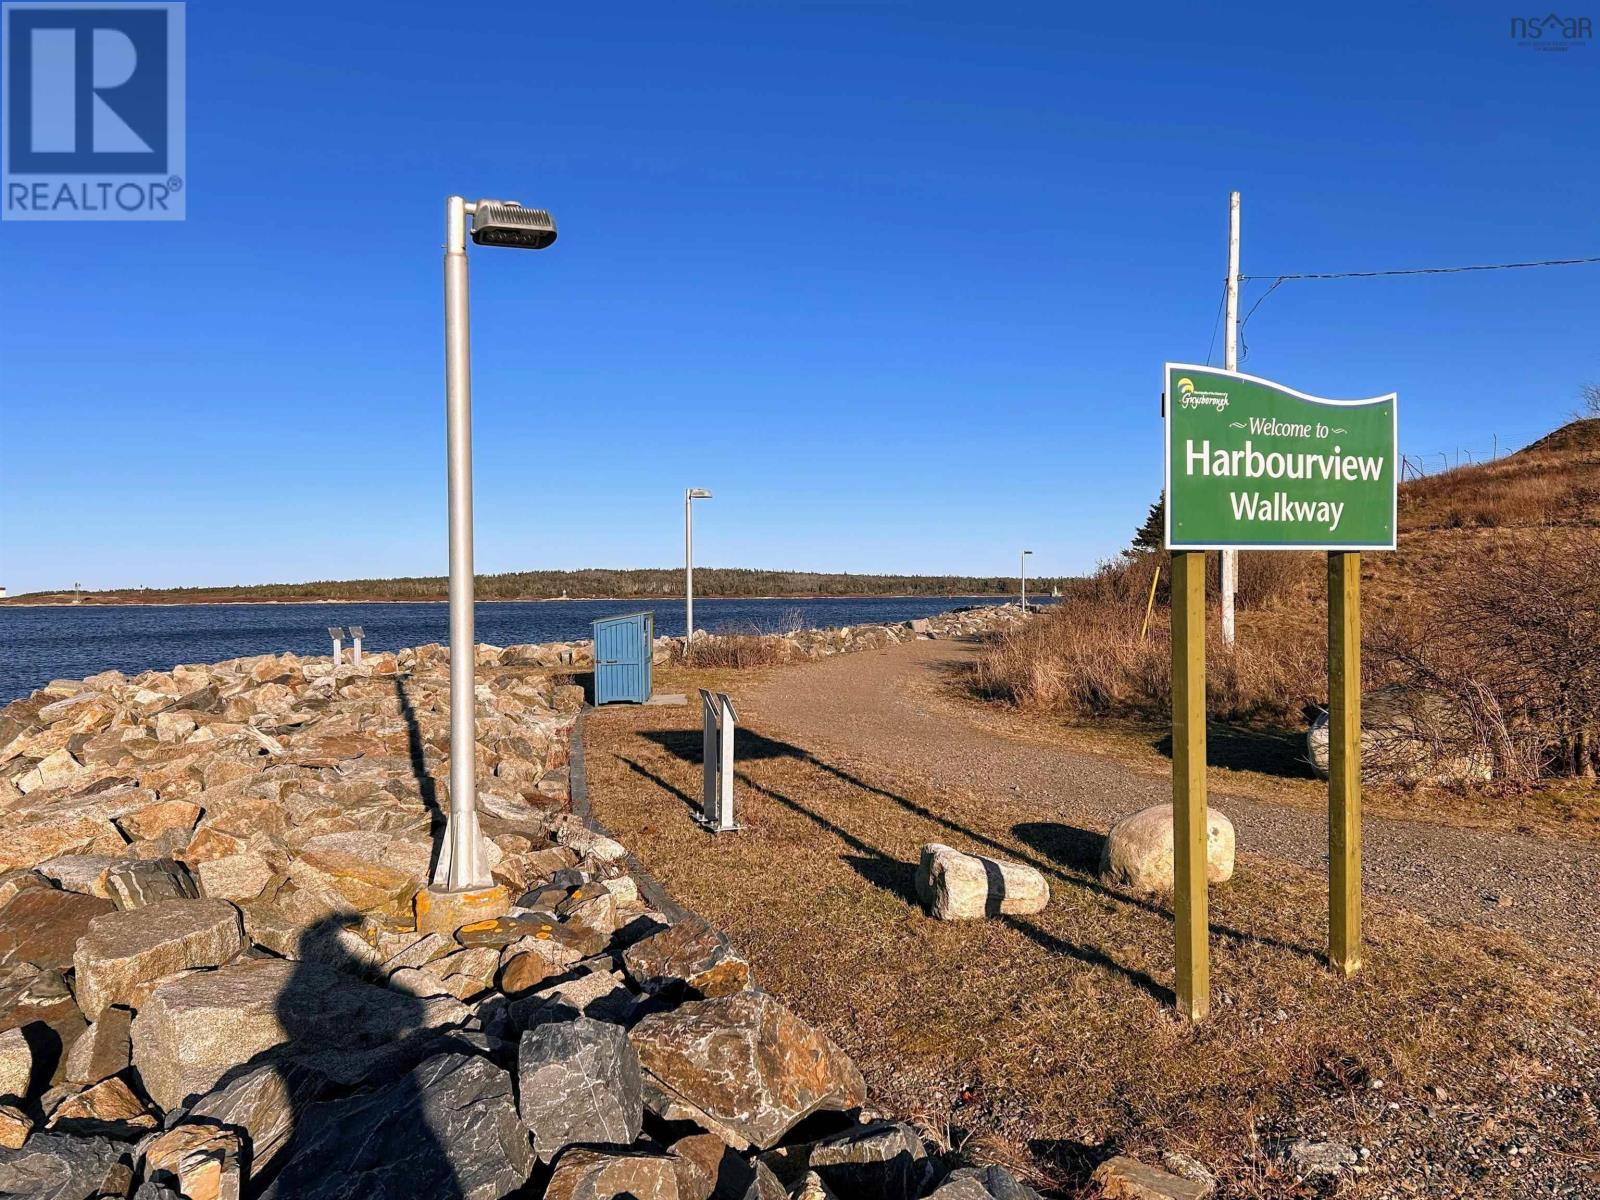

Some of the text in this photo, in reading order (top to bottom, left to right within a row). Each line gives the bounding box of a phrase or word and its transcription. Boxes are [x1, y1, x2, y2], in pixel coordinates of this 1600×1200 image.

[1249, 416, 1329, 439] Welcome to
[1186, 439, 1384, 481] Harbourview
[1230, 491, 1345, 531] Walkway
